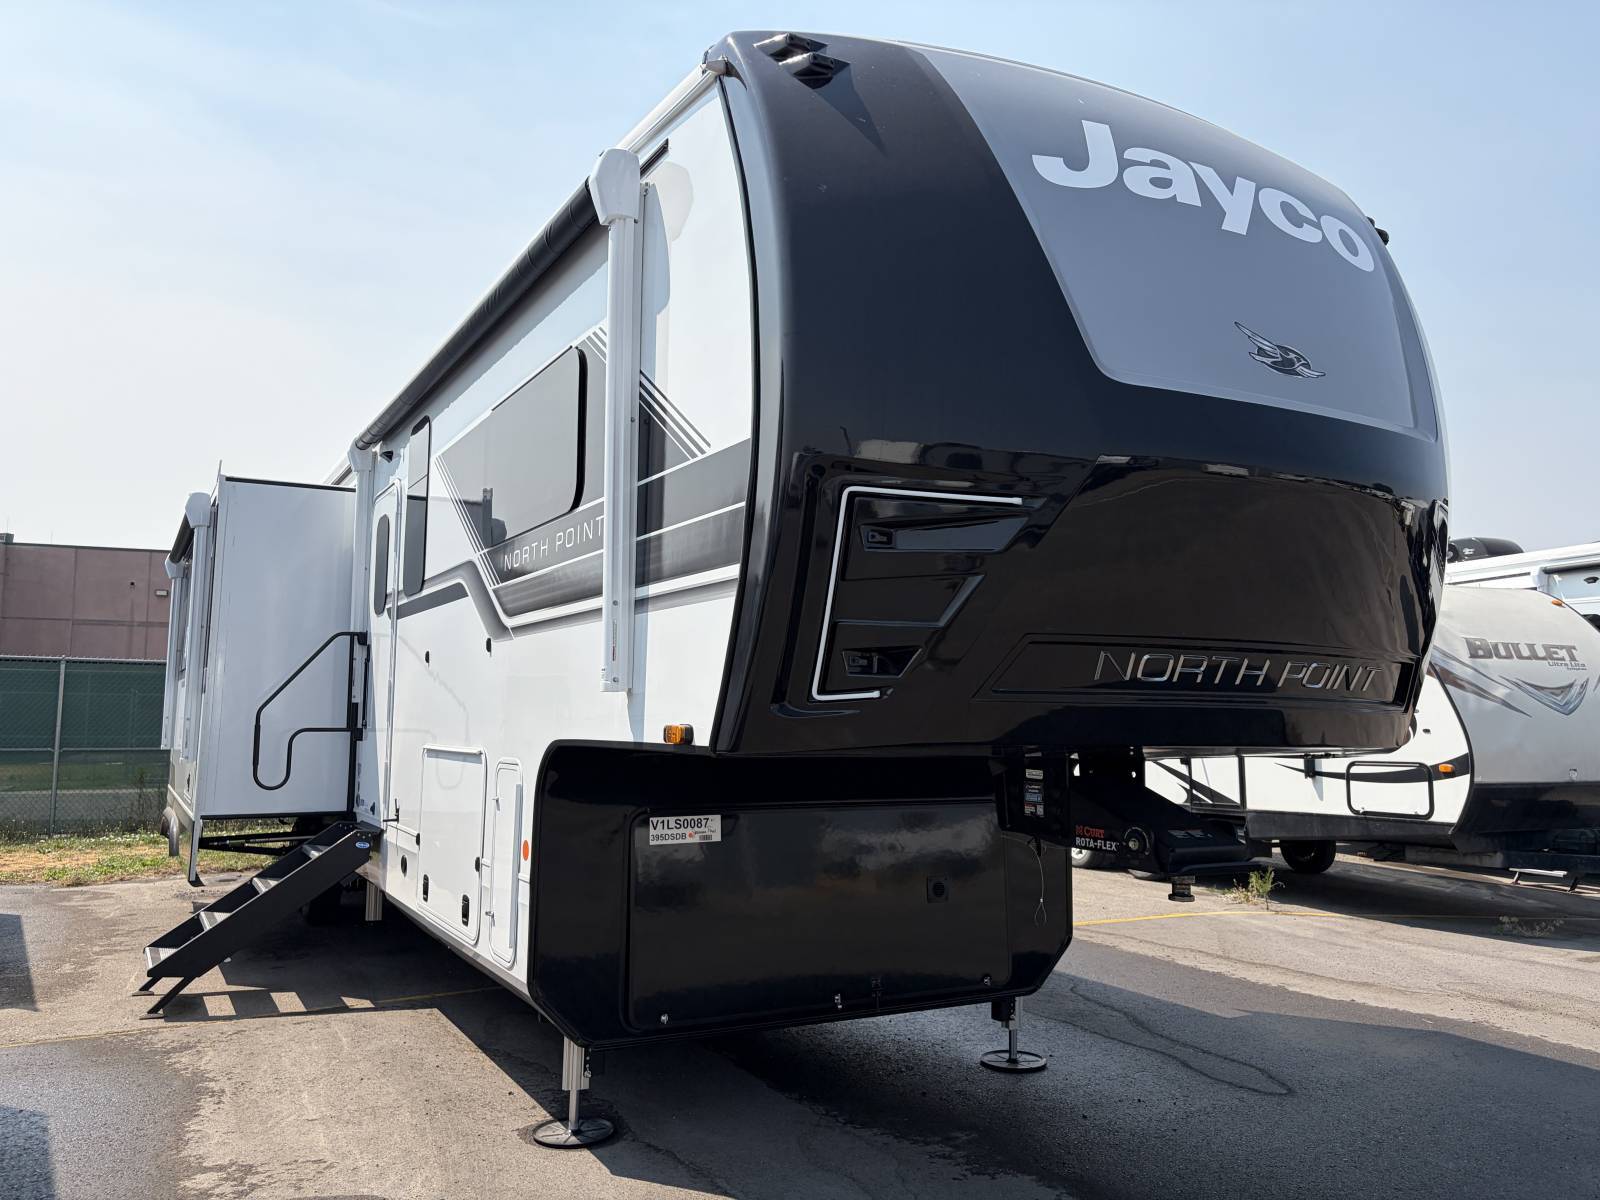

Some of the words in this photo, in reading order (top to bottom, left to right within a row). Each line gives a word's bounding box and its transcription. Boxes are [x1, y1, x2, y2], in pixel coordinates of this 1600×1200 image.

[1031, 119, 1375, 272] Jayco
[503, 538, 549, 572] NORTH
[555, 515, 605, 552] POINT
[1463, 638, 1578, 661] BULLET
[1094, 650, 1271, 686] NORTH
[1277, 660, 1384, 692] POINT
[651, 818, 709, 830] V1LS0087
[651, 833, 686, 841] 395DSDB
